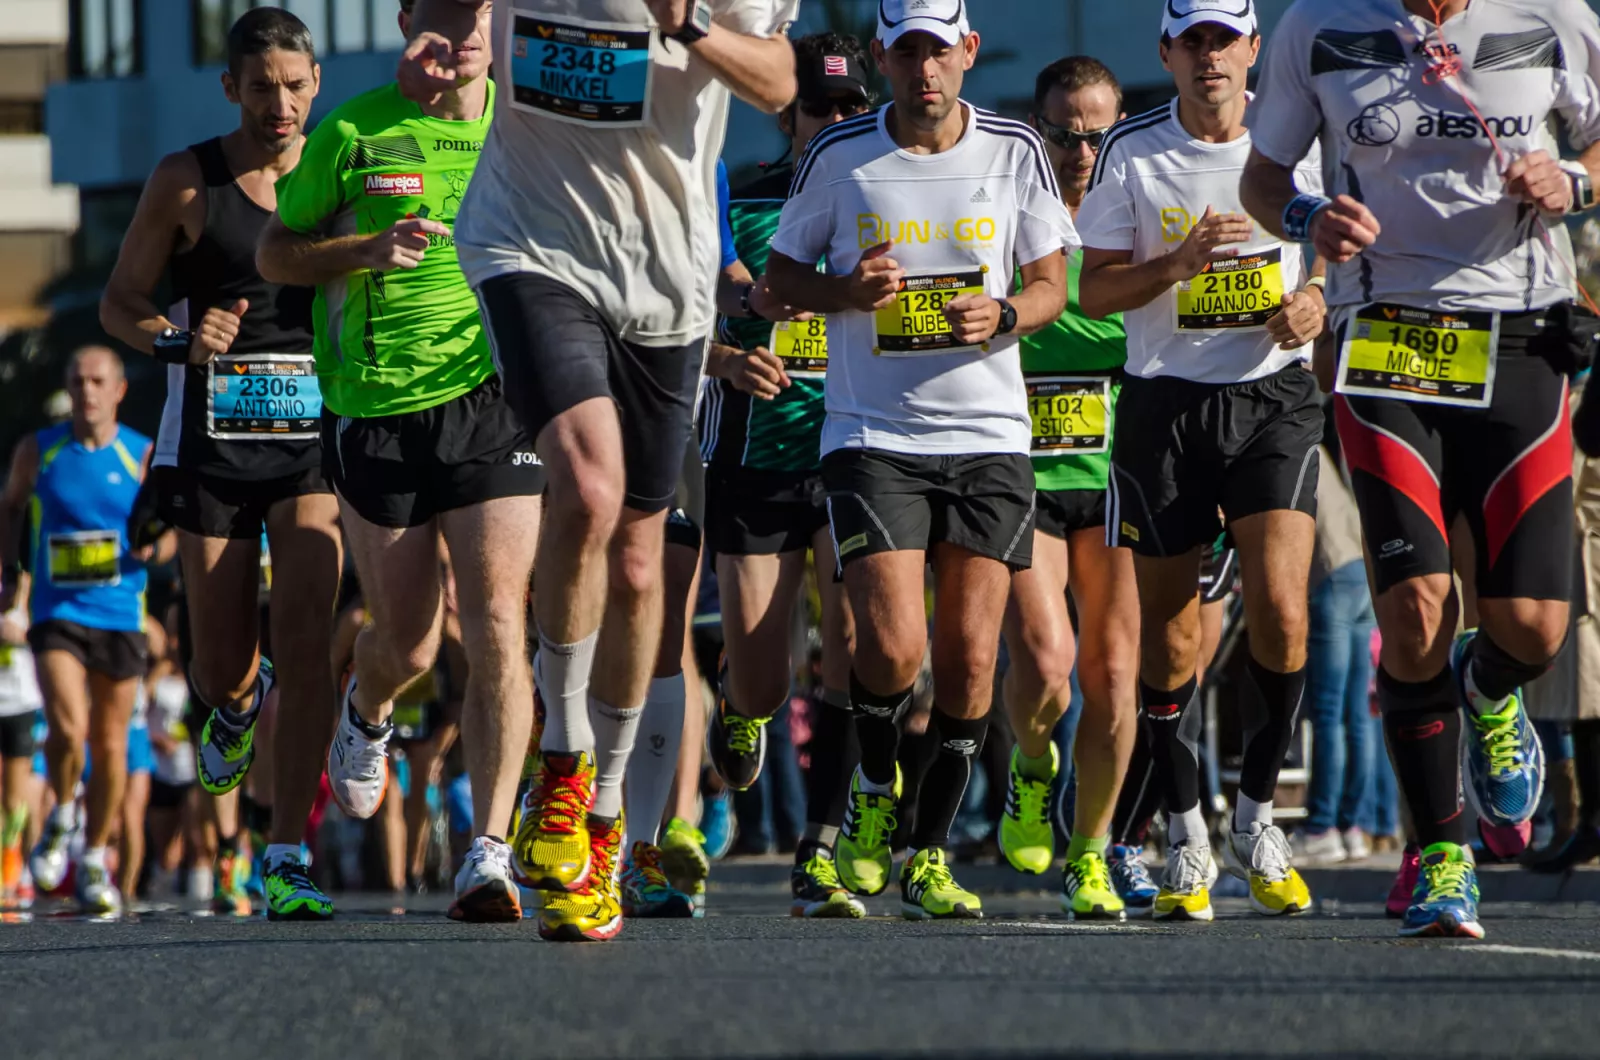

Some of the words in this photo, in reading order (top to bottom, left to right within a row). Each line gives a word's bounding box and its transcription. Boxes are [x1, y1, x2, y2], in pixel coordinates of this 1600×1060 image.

[540, 43, 615, 75] 2348
[540, 70, 614, 100] MIKKEL
[366, 175, 420, 190] Altarejos
[857, 213, 930, 249] RUN
[953, 217, 996, 242] GO
[1204, 271, 1263, 294] 2180
[1192, 293, 1257, 314] JUANJO
[1389, 326, 1459, 355] 1690
[1385, 350, 1453, 378] MIGUE
[240, 378, 298, 397] 2306
[233, 399, 305, 417] ANTONIO
[1031, 397, 1083, 416] 1102
[1040, 417, 1073, 435] STIG
